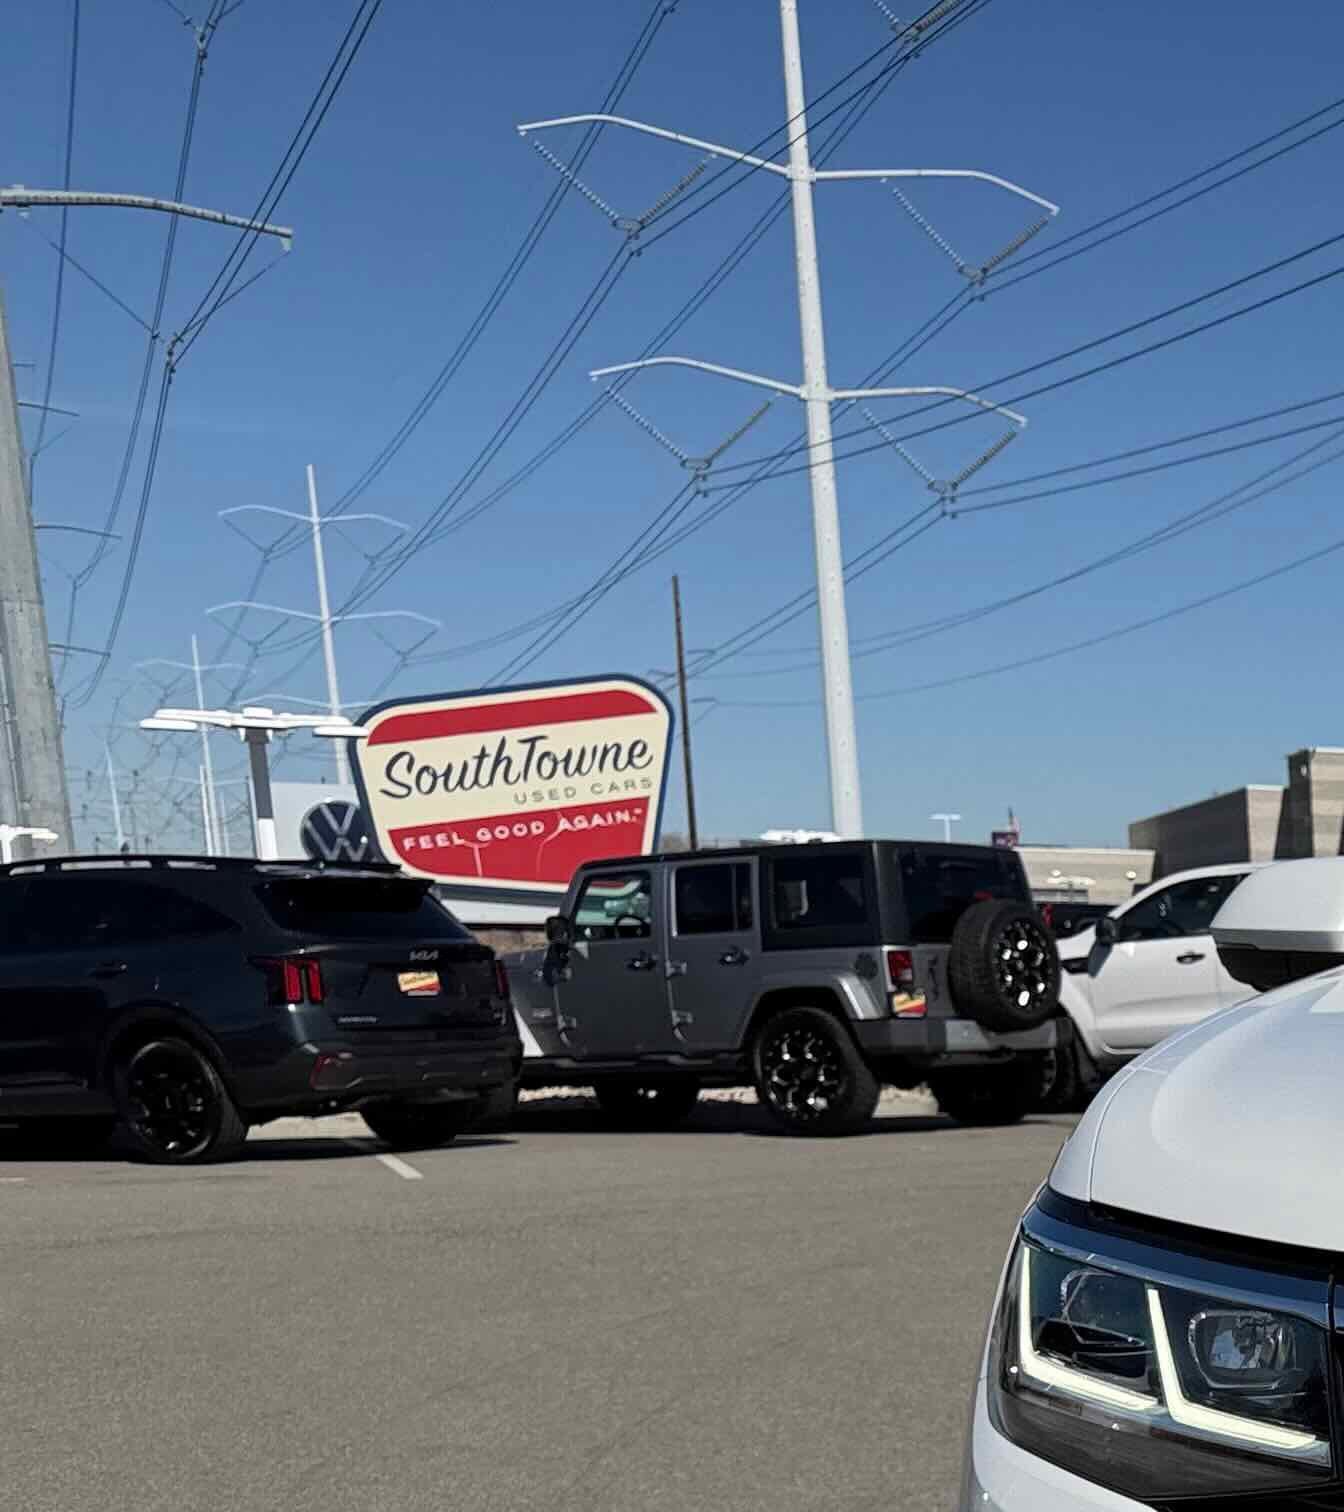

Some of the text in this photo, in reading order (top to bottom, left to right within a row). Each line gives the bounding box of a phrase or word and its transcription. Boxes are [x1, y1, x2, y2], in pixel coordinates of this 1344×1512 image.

[379, 736, 653, 799] SouthTowne
[513, 777, 653, 805] USED CARS
[402, 829, 465, 851] FEEL
[476, 819, 545, 842] GOOD
